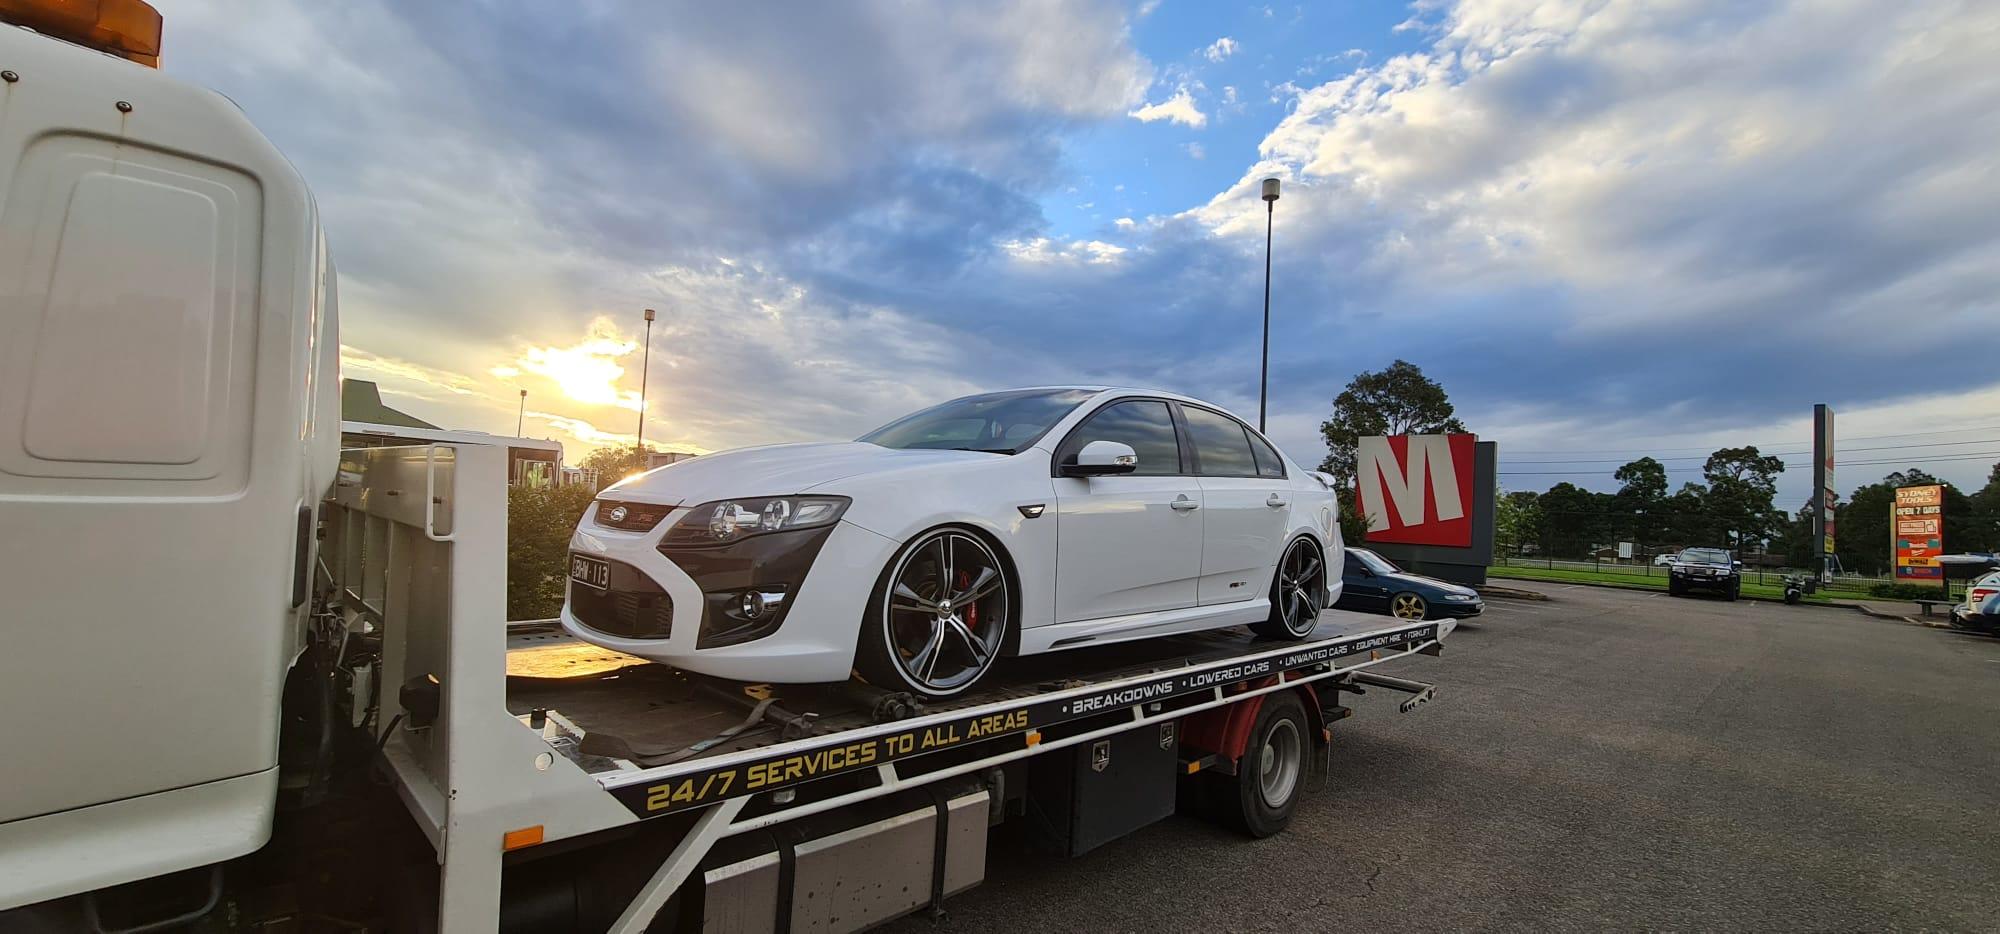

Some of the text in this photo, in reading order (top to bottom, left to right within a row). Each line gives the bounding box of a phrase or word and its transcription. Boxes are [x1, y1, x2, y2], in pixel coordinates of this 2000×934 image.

[1357, 434, 1464, 532] M
[1897, 489, 1936, 498] SYDNEY
[1901, 496, 1932, 504] TOOLS
[1897, 505, 1941, 515] OPEN 7 DAYS
[1072, 628, 1430, 714] BREAKDOWNS LOWERED CARS UNWANTED CARS EQUIPMENT HIRE FORKLIFT
[647, 710, 1028, 811] 24/7 SERVICES TO ALL AREAS
